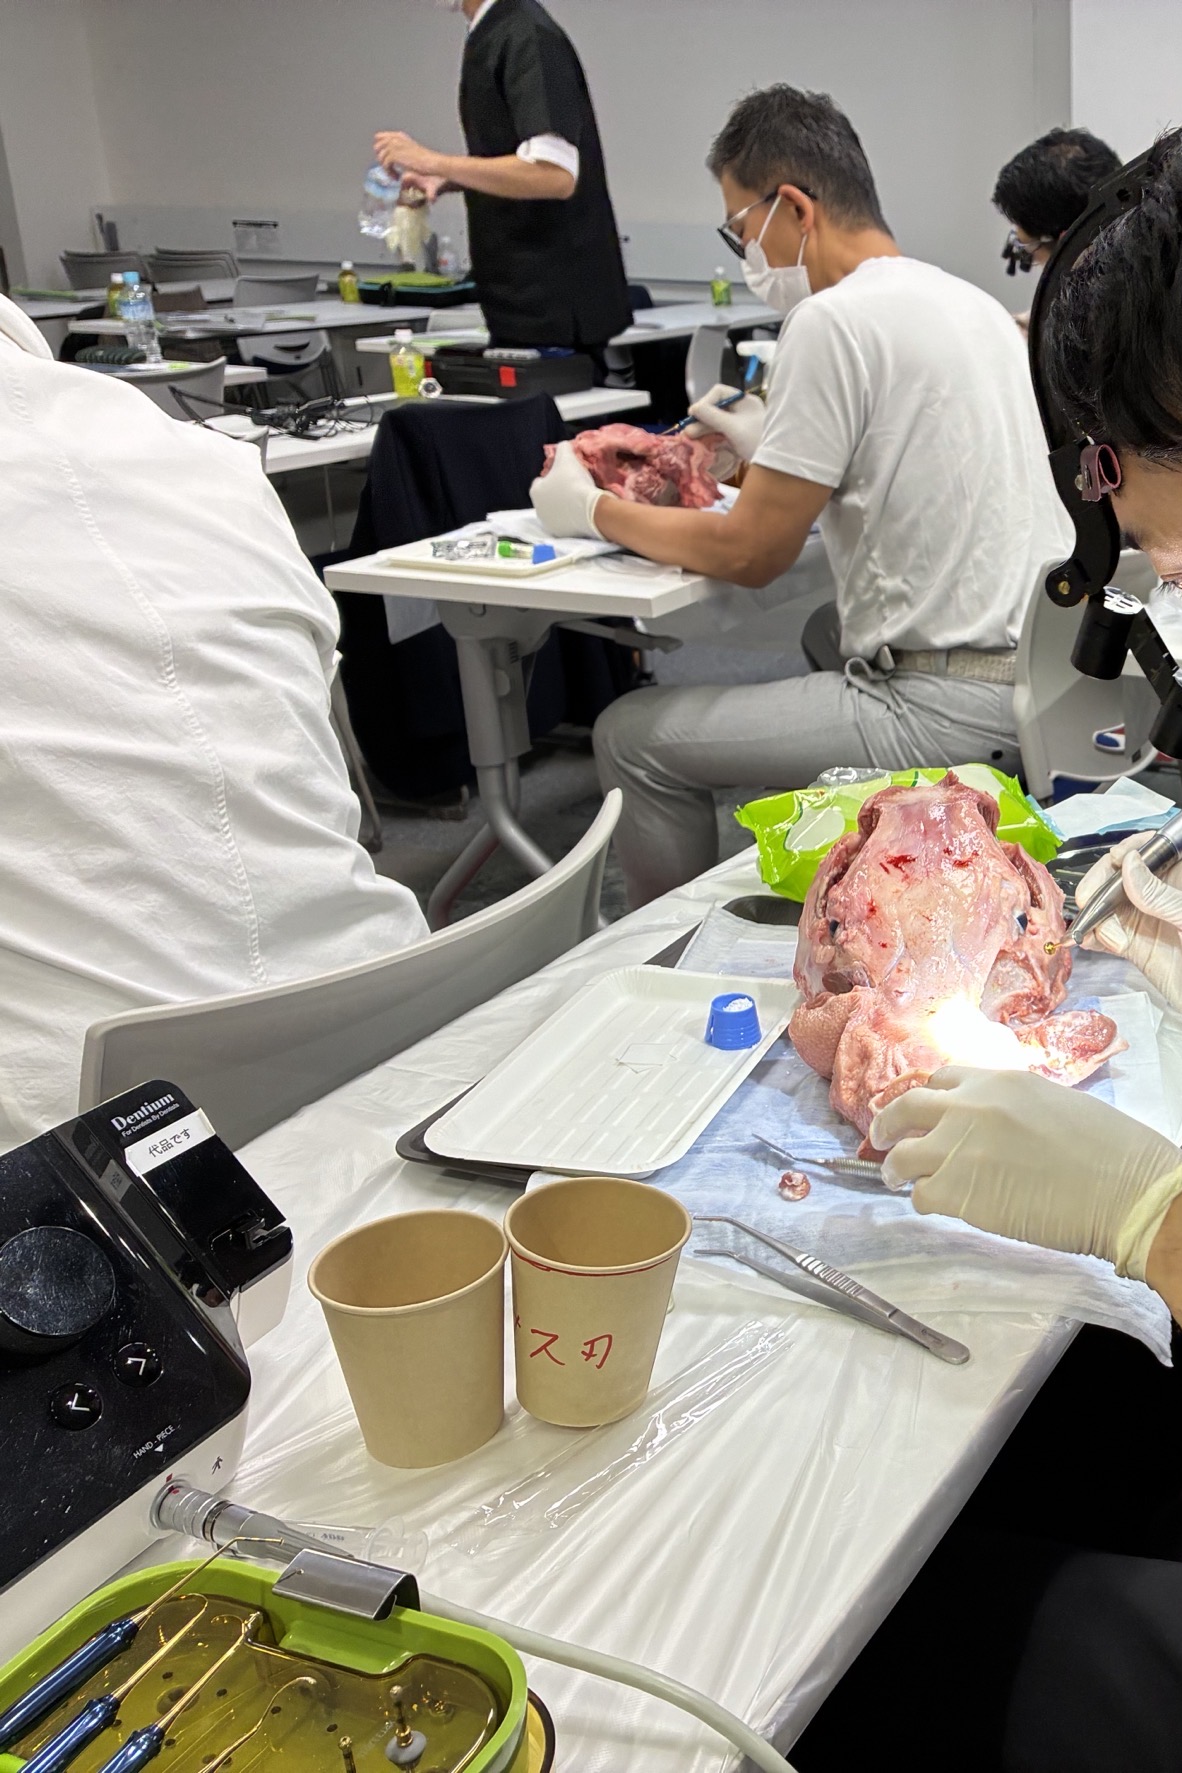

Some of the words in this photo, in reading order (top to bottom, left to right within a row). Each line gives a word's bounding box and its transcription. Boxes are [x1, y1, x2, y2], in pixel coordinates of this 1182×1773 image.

[111, 1093, 175, 1131] Dentium
[121, 1129, 132, 1138] For
[159, 1103, 180, 1117] Dentists
[148, 1128, 191, 1157] 代品です
[133, 1441, 154, 1459] HAND
[156, 1424, 176, 1442] PIECE
